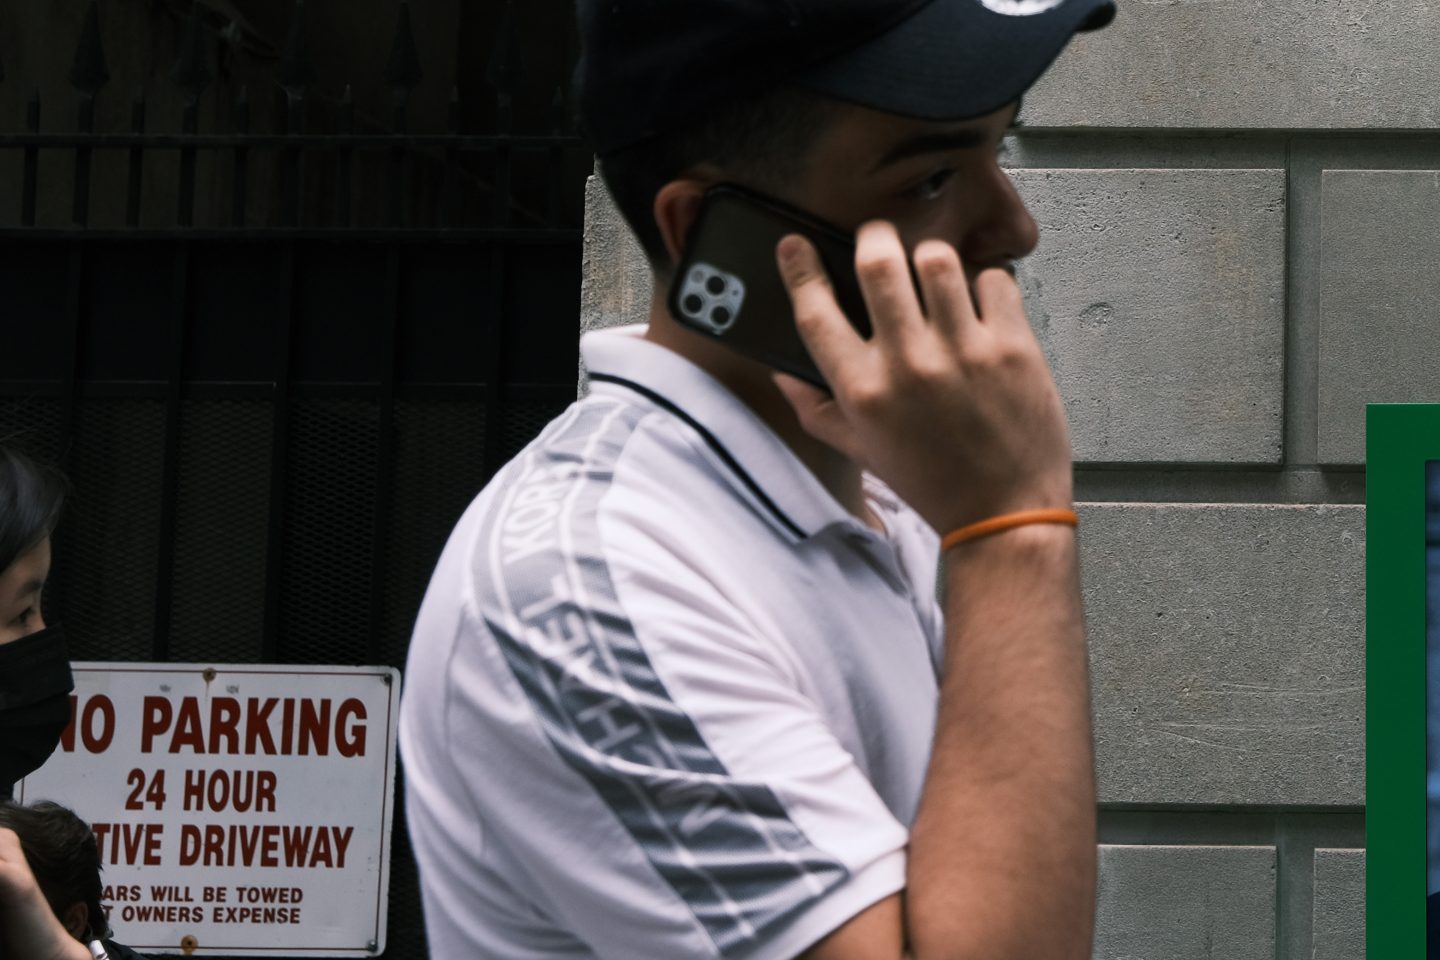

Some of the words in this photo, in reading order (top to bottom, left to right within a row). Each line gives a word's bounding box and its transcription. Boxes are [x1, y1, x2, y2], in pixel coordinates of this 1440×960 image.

[140, 695, 368, 758] PARKING
[125, 767, 166, 811] 24
[183, 769, 277, 813] HOUR
[92, 823, 164, 866] TIVE
[179, 824, 354, 868] DRIVEWAY
[102, 885, 142, 901] ARS
[151, 886, 194, 902] WILL
[203, 887, 227, 902] BE
[236, 887, 304, 904] TOWED
[103, 906, 114, 921] T
[121, 906, 204, 922] OWNERS
[212, 907, 301, 923] EXPENSE
